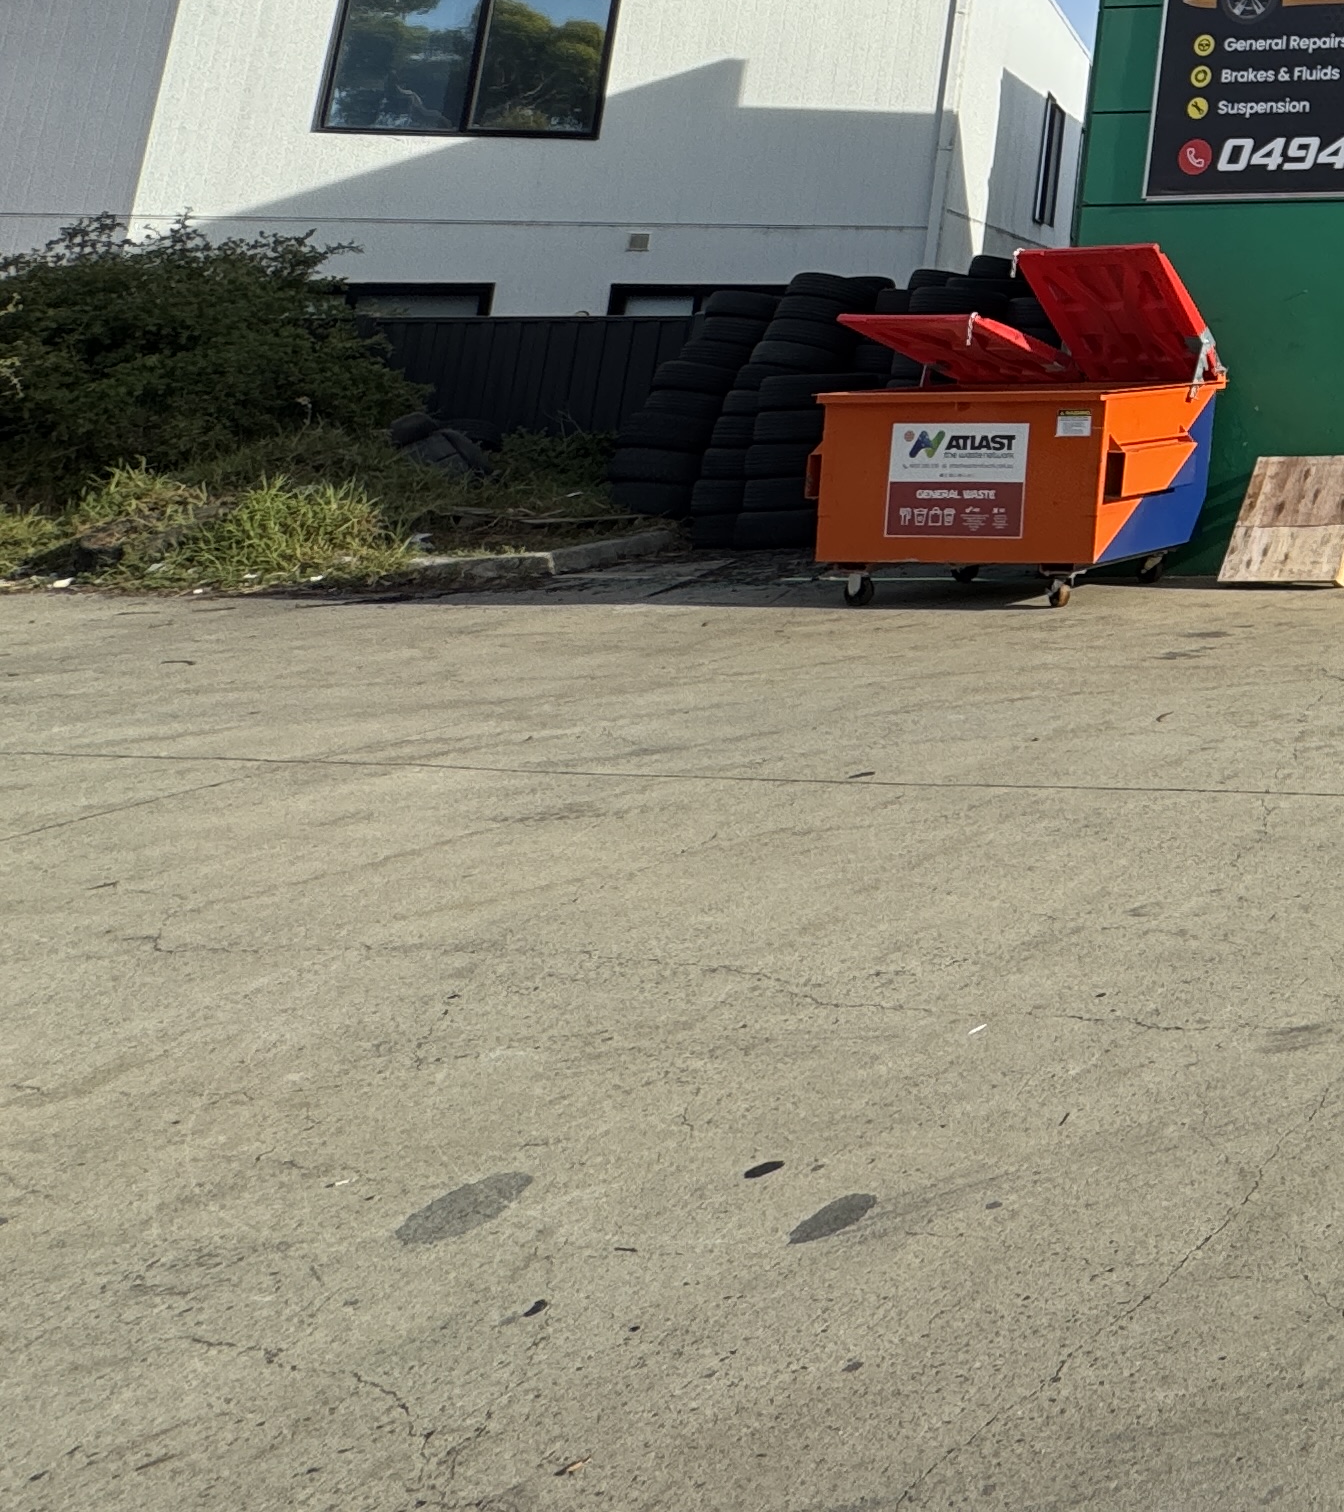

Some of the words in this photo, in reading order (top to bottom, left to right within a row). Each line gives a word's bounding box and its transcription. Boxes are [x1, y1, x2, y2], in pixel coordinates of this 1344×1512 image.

[1224, 35, 1286, 52] General
[1221, 68, 1275, 83] Brakes
[1278, 67, 1290, 82] &
[1294, 65, 1341, 81] Fluids
[1217, 97, 1311, 119] Suspension
[945, 435, 1016, 451] ATLAST
[916, 490, 961, 499] GENERAL
[963, 490, 996, 499] WASTE
